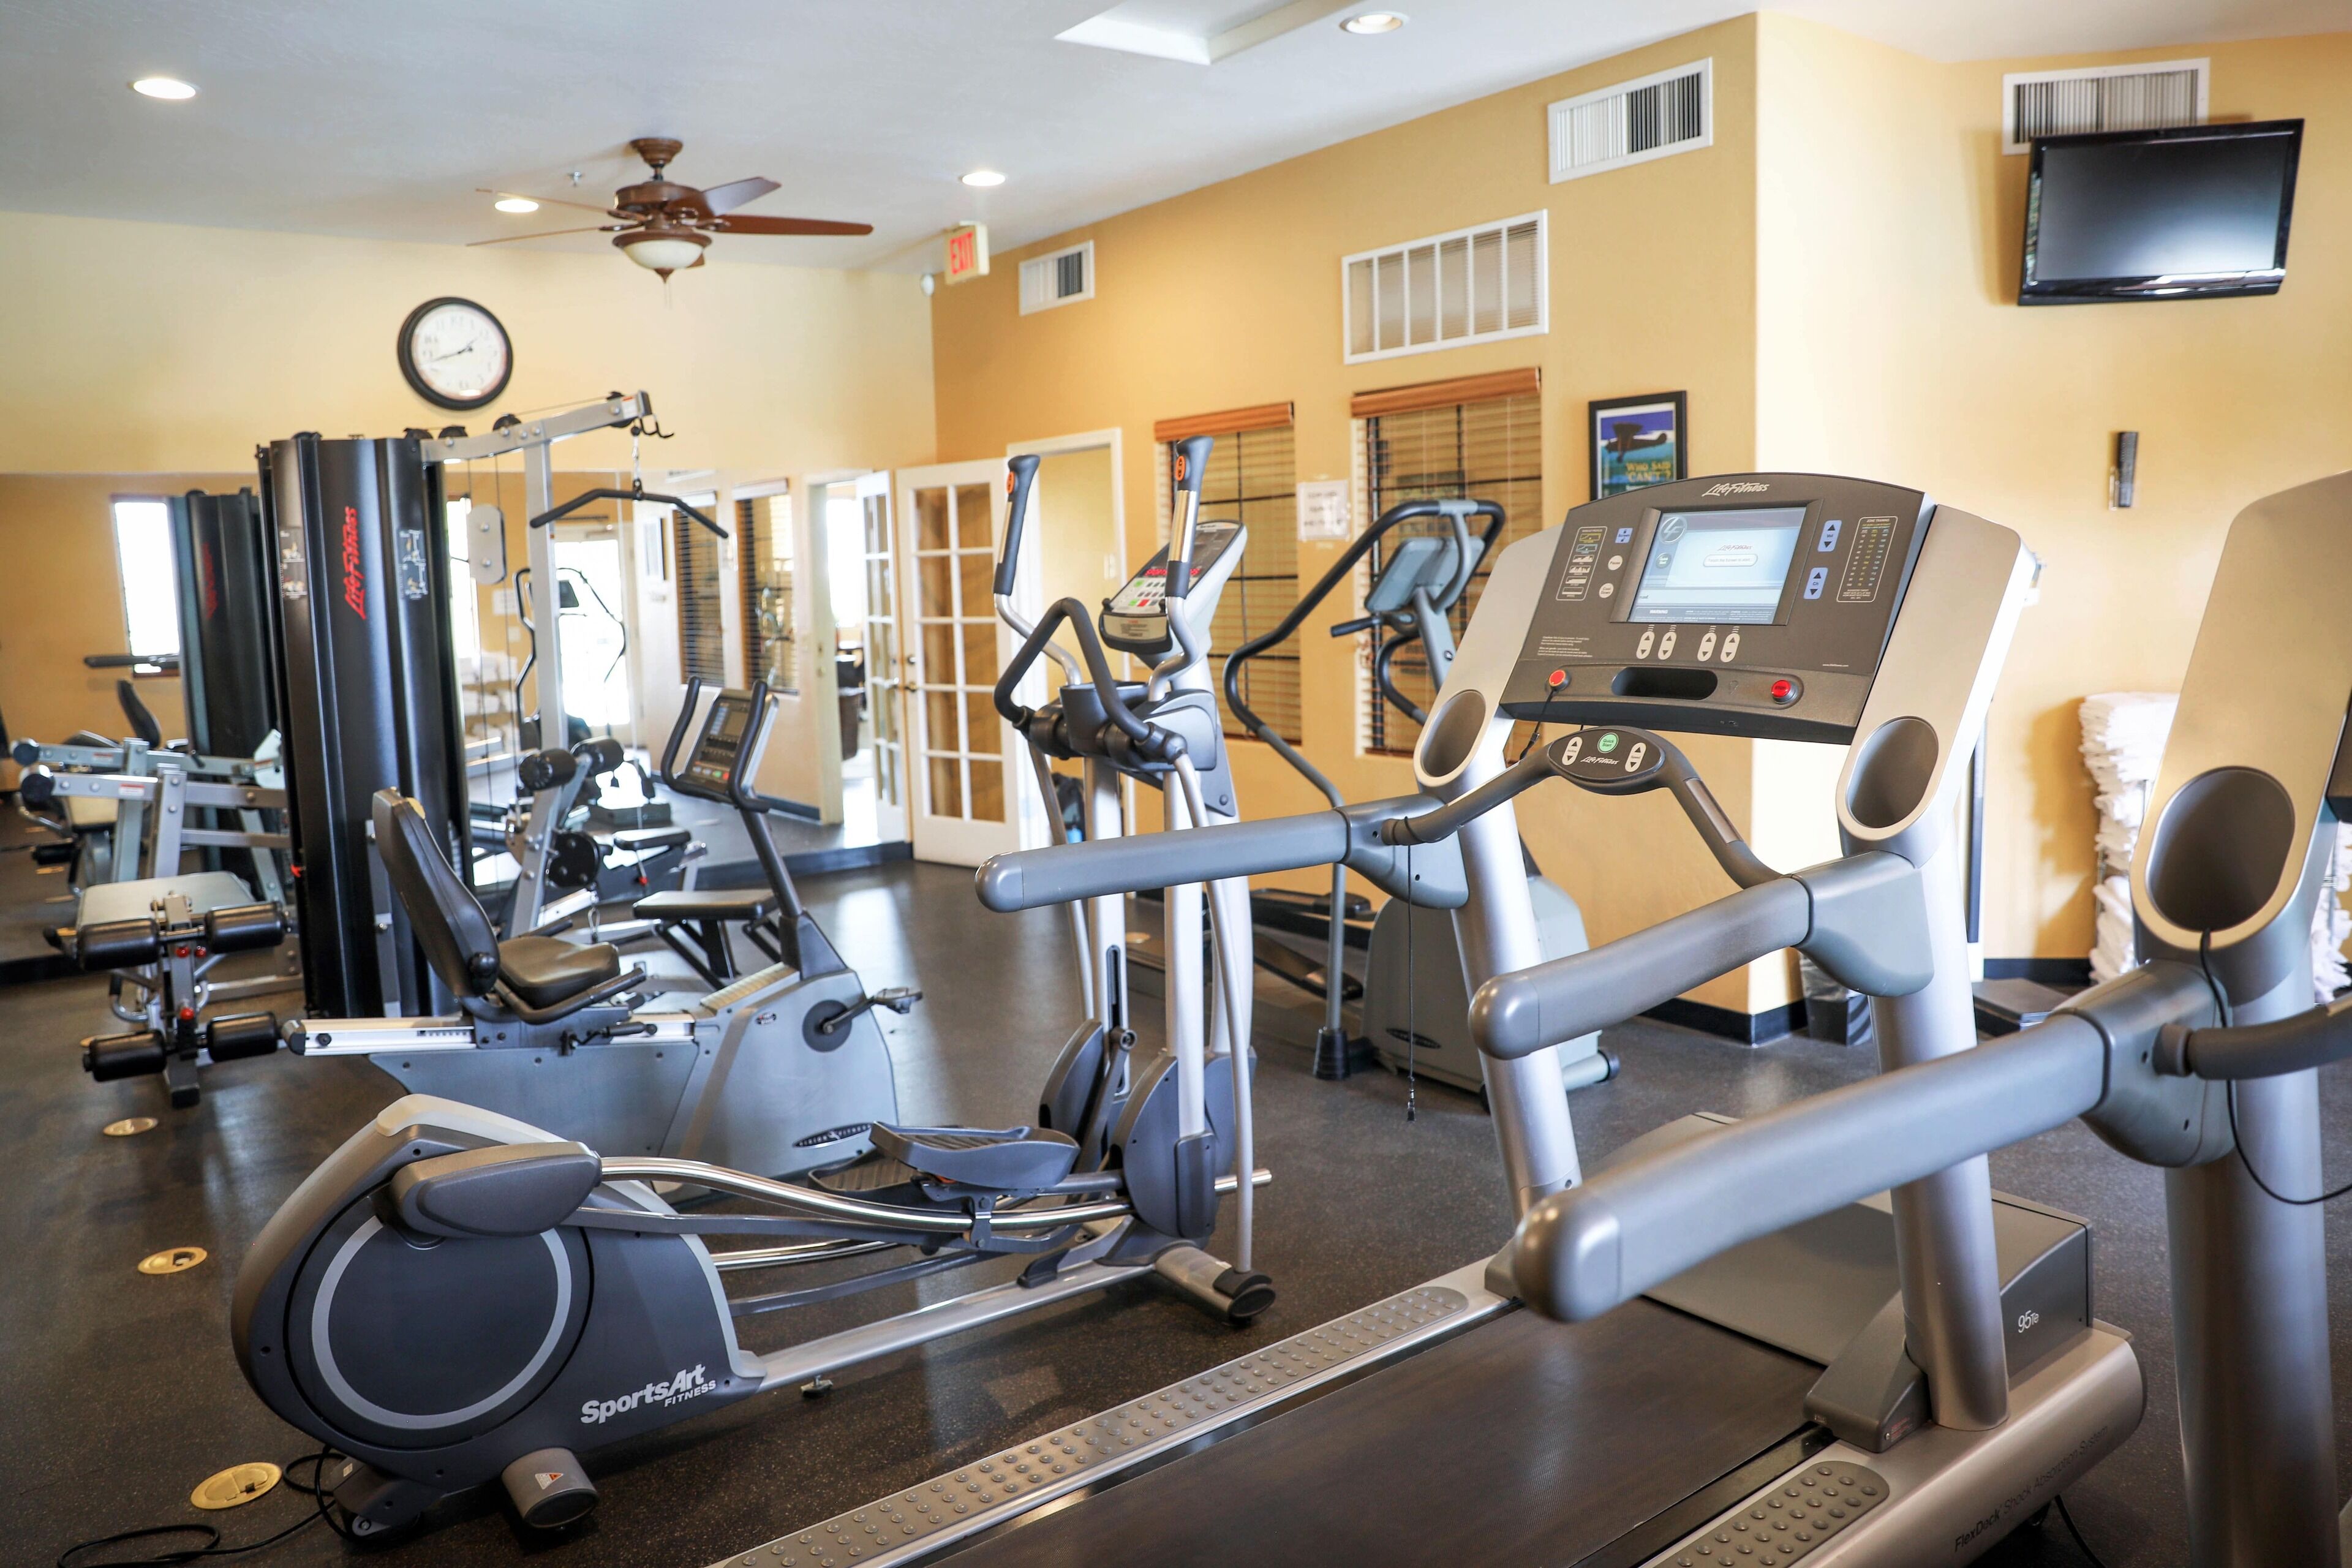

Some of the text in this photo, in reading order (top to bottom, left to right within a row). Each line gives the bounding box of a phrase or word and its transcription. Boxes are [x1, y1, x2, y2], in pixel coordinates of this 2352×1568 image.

[950, 232, 974, 274] EXIT
[581, 1363, 706, 1424] SportsArt
[664, 1380, 717, 1408] FITNESS
[2003, 1485, 2032, 1514] Shock
[2079, 1425, 2108, 1455] System
